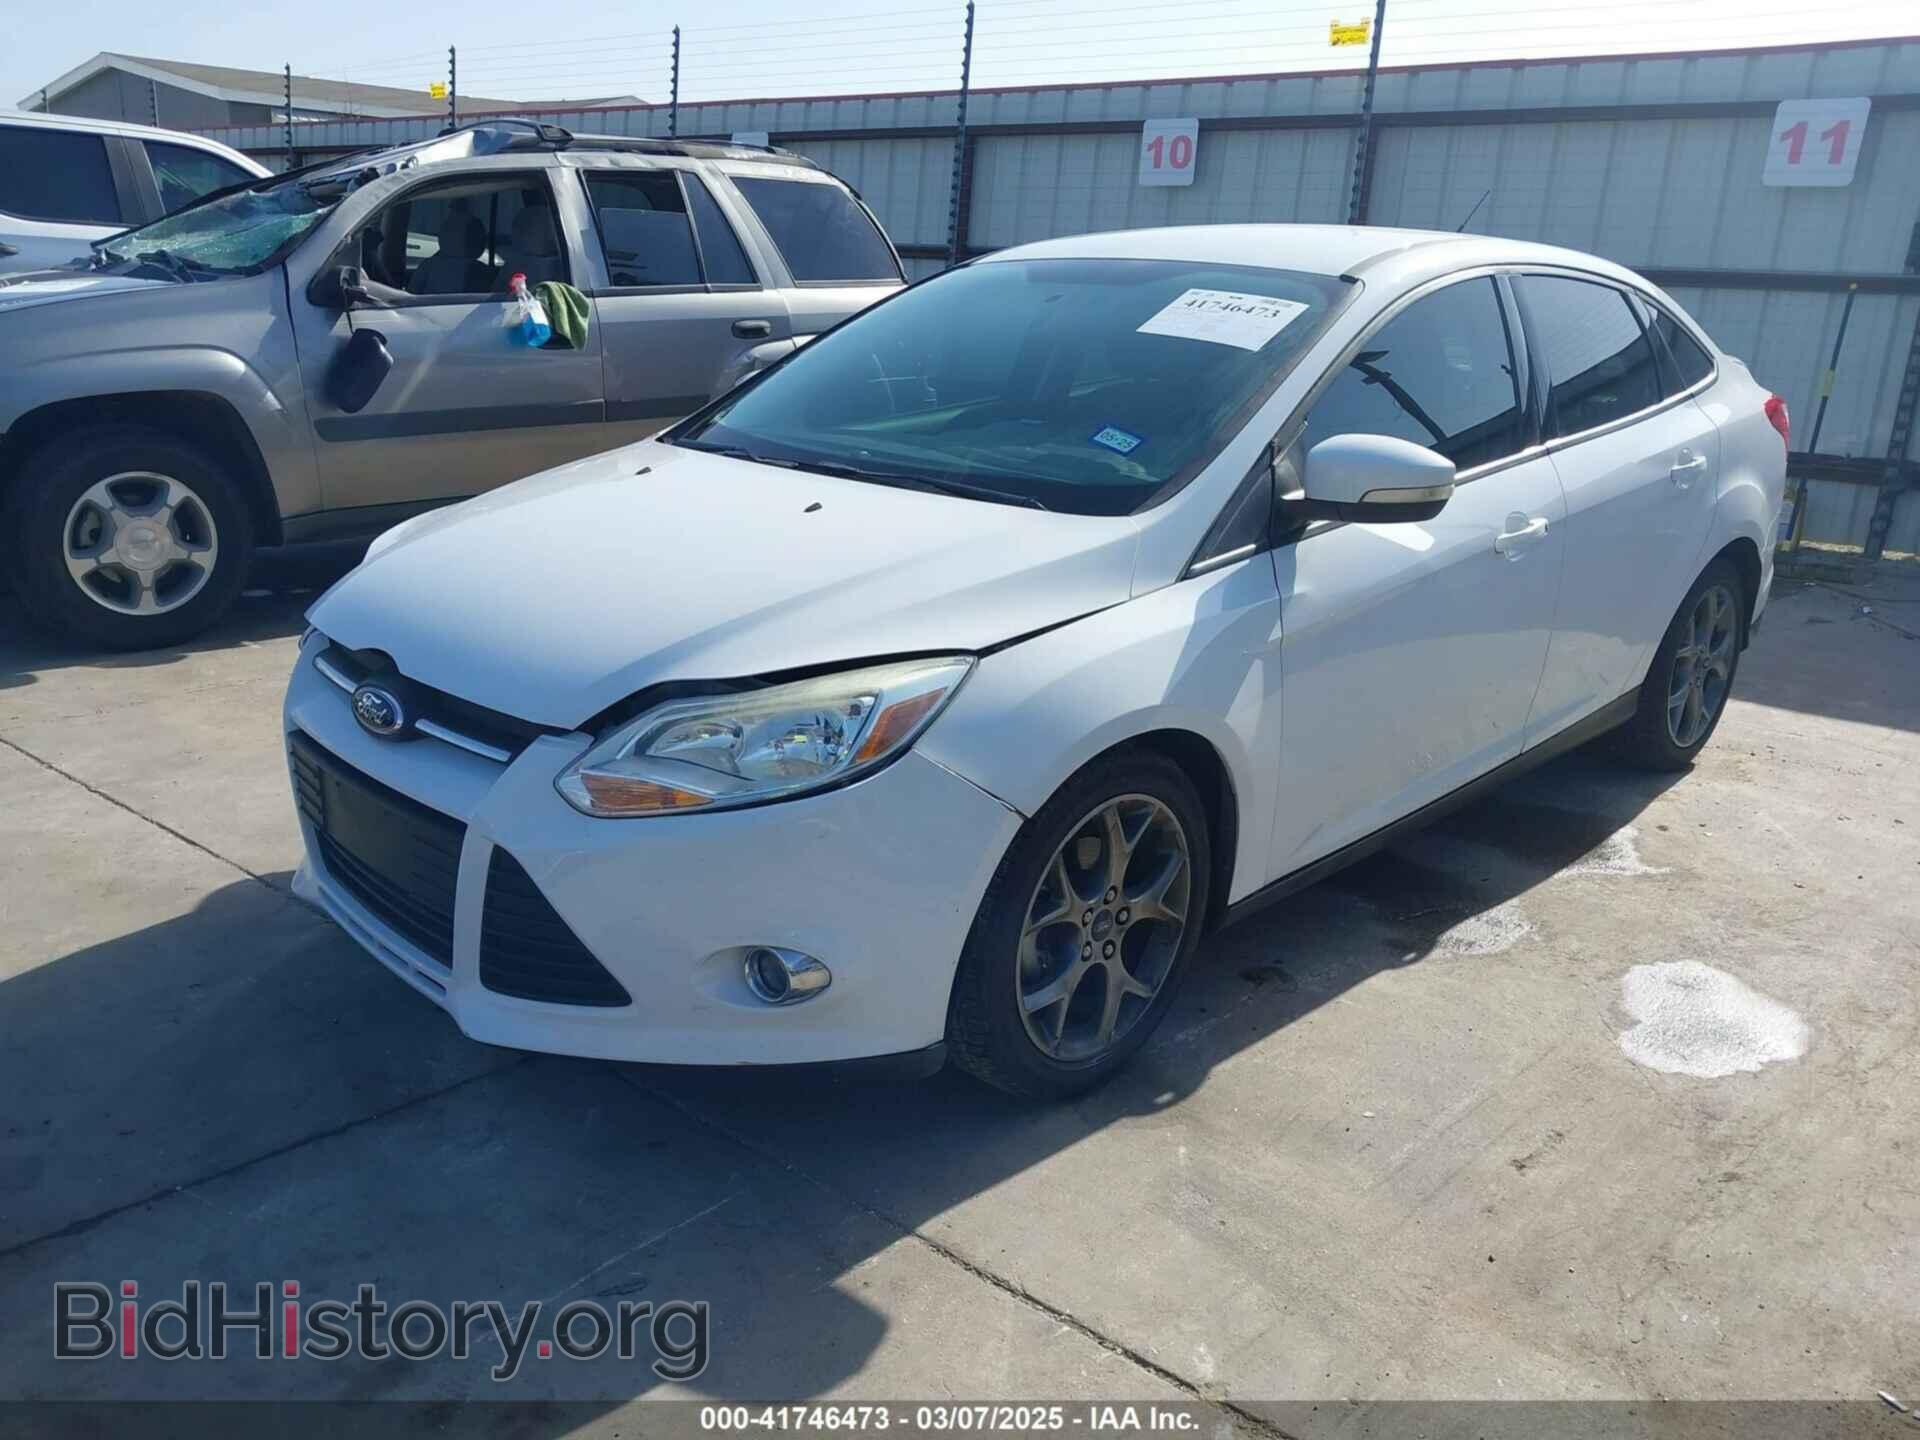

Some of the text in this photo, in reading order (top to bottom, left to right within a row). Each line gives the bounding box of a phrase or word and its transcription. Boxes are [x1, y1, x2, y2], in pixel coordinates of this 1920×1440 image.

[1147, 135, 1192, 169] 10
[1780, 120, 1851, 165] 11
[1184, 299, 1281, 319] 41746473
[357, 692, 388, 725] Ford
